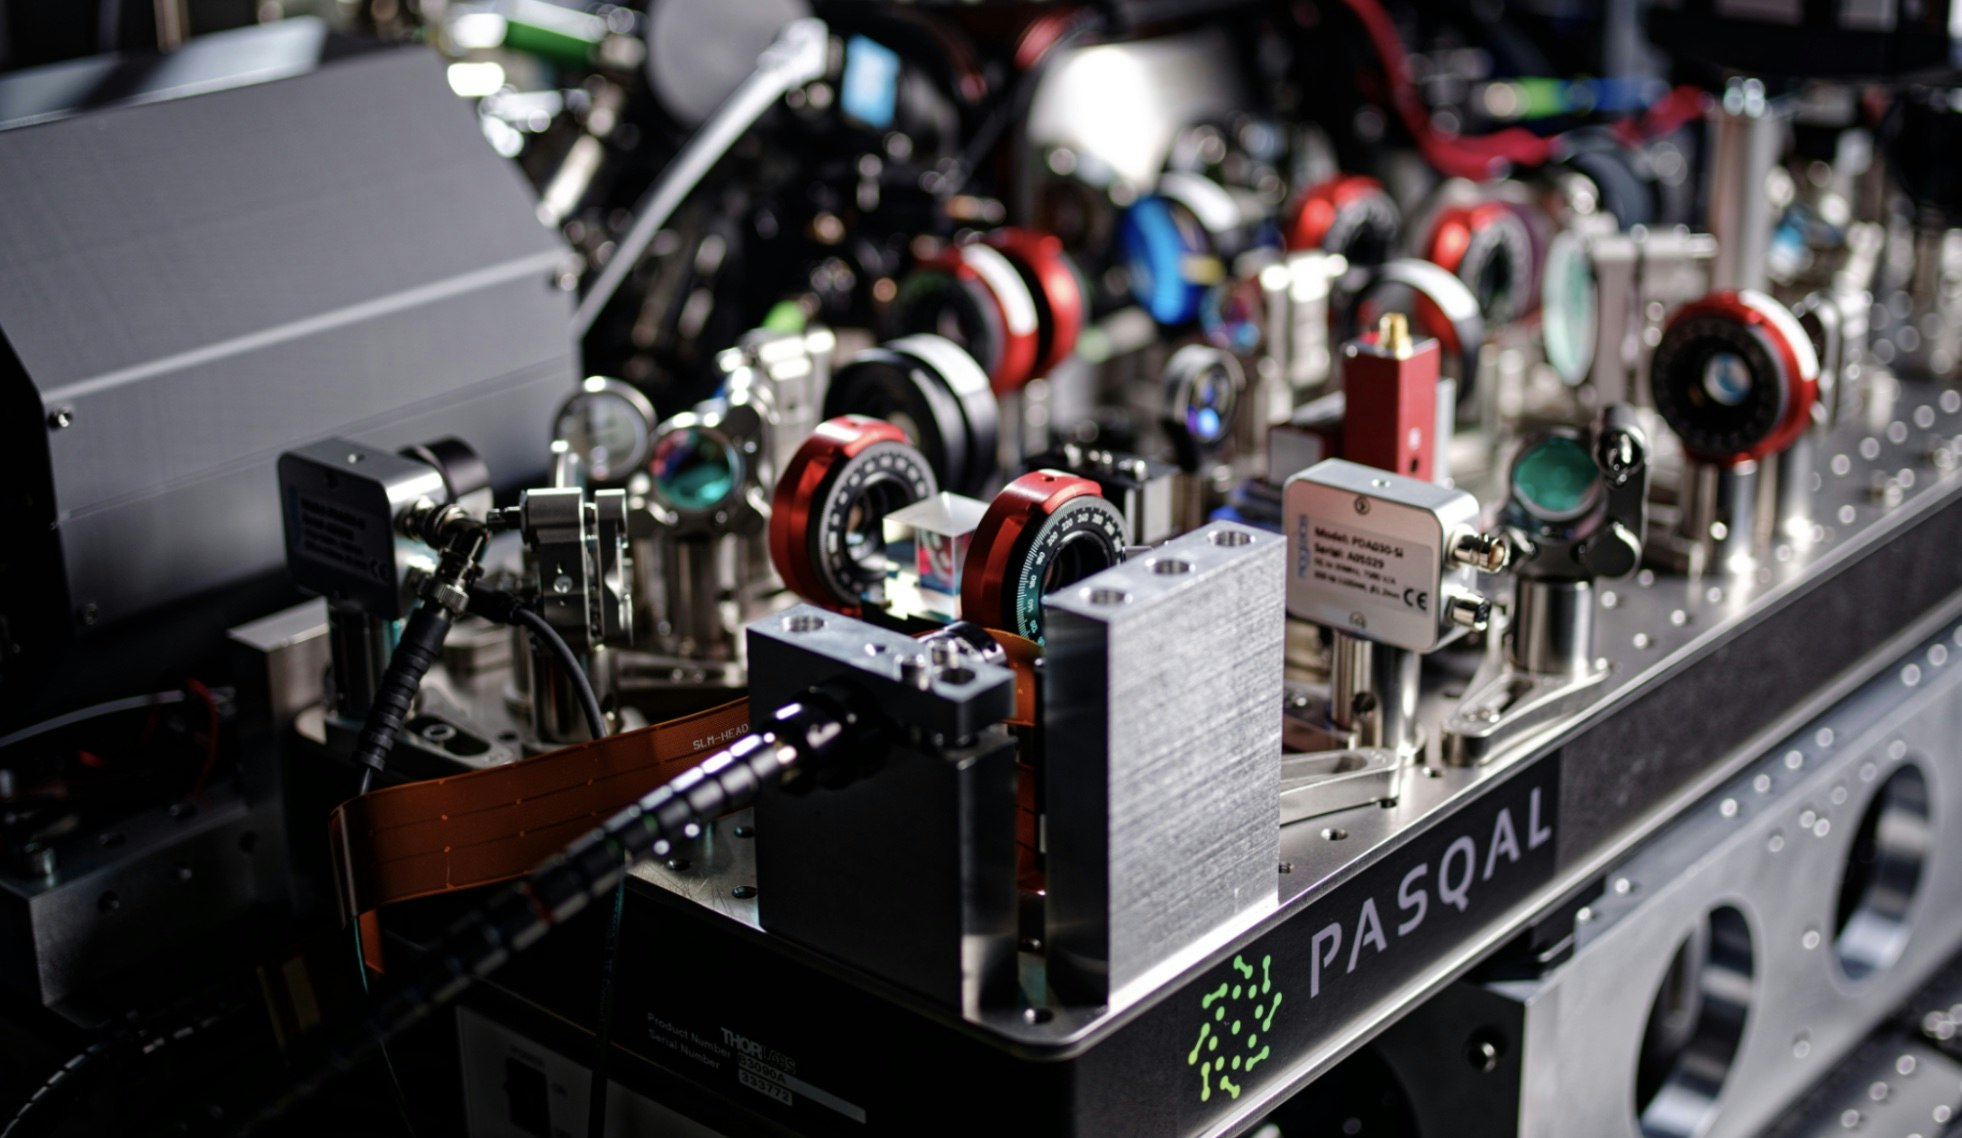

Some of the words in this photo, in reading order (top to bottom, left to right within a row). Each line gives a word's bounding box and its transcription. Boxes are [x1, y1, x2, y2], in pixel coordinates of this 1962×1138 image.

[692, 723, 750, 751] SLM-HEAD
[1310, 786, 1552, 999] PASQAL
[647, 1012, 689, 1041] Product
[691, 1032, 731, 1059] Number
[648, 1028, 678, 1050] Serial
[681, 1043, 721, 1070] Number
